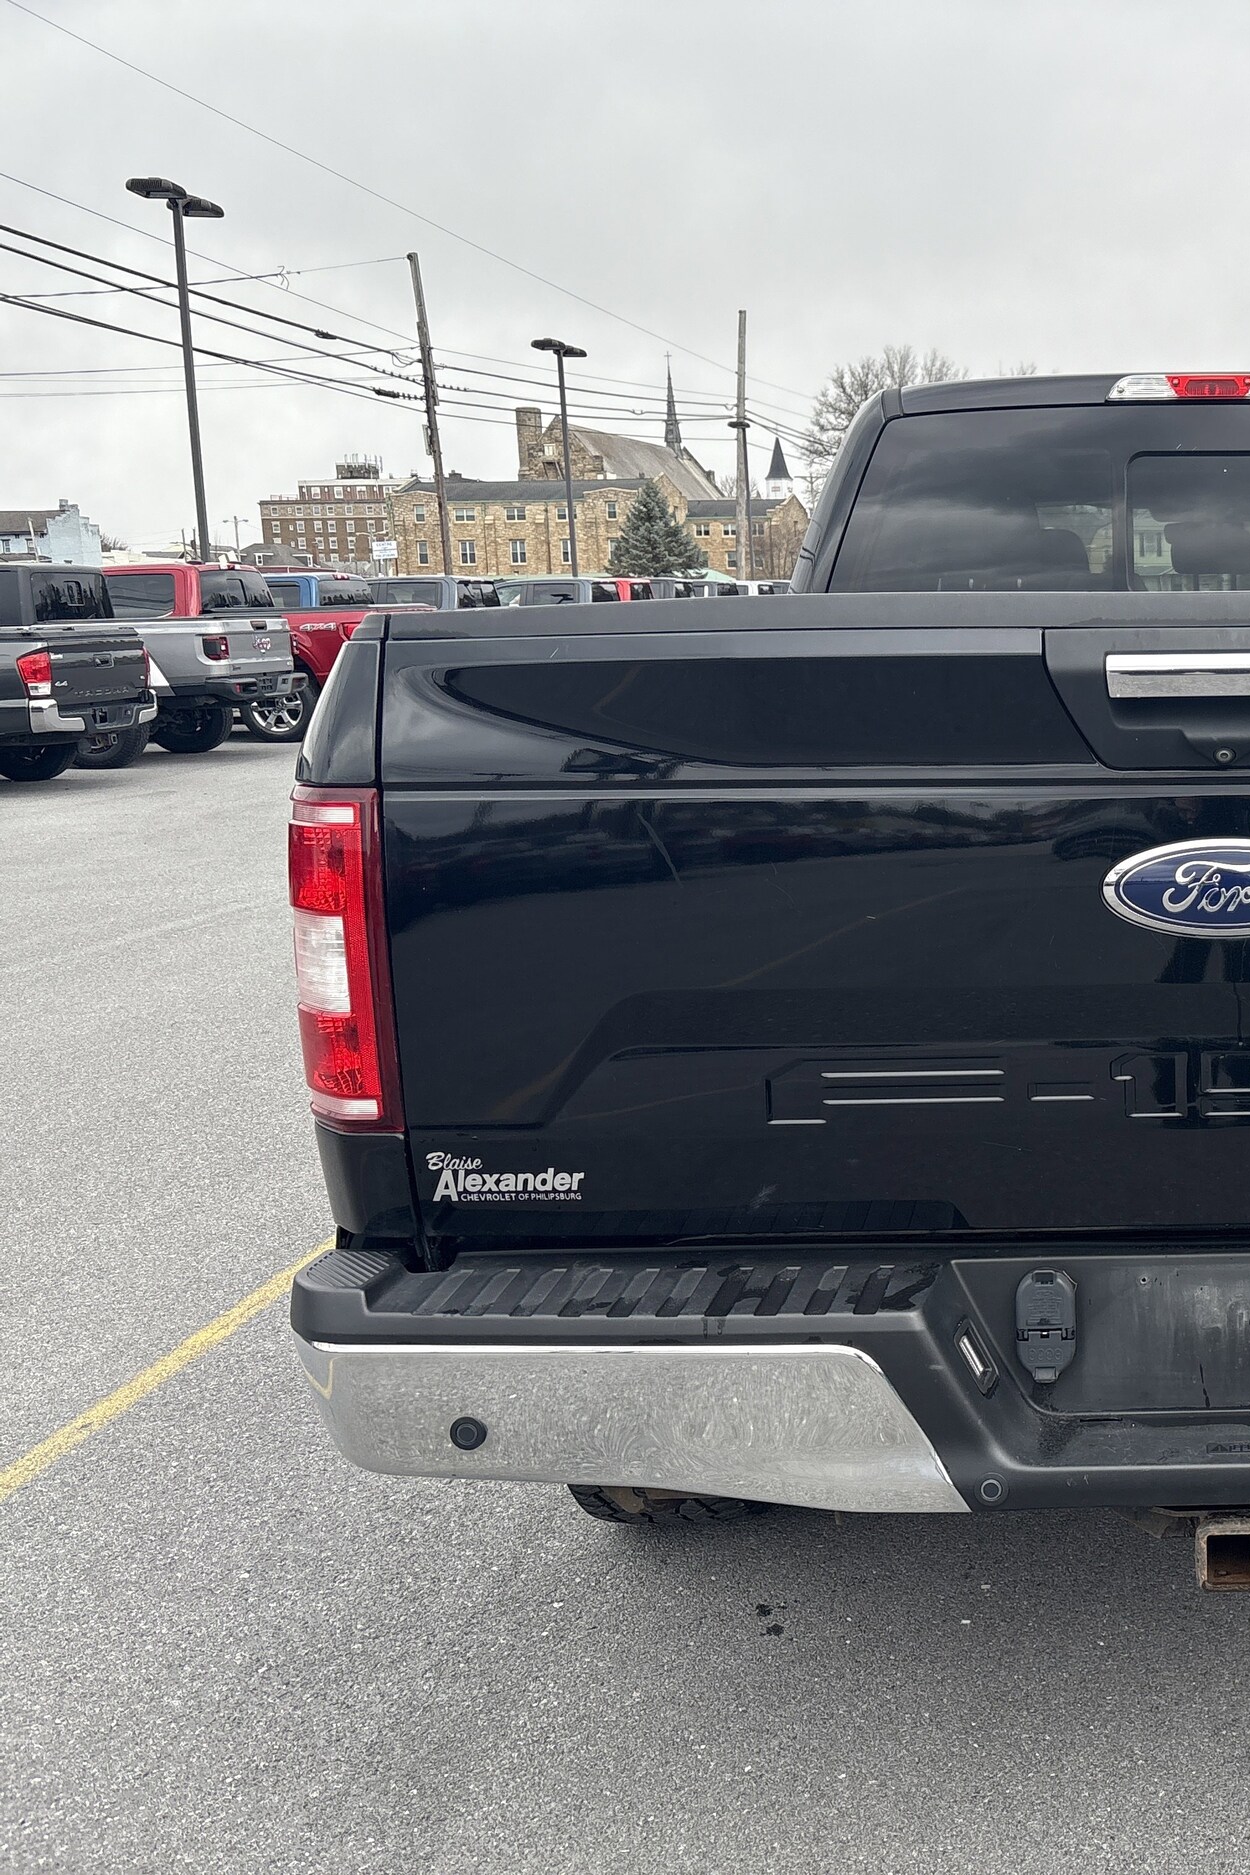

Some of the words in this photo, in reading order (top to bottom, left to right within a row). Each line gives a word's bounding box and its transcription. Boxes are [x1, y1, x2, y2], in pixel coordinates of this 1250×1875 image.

[425, 1151, 483, 1171] Blaise
[432, 1167, 585, 1202] Alexander
[460, 1193, 516, 1201] CHEVROLET
[518, 1193, 530, 1201] OF
[531, 1192, 582, 1201] PHILIPSBURG
